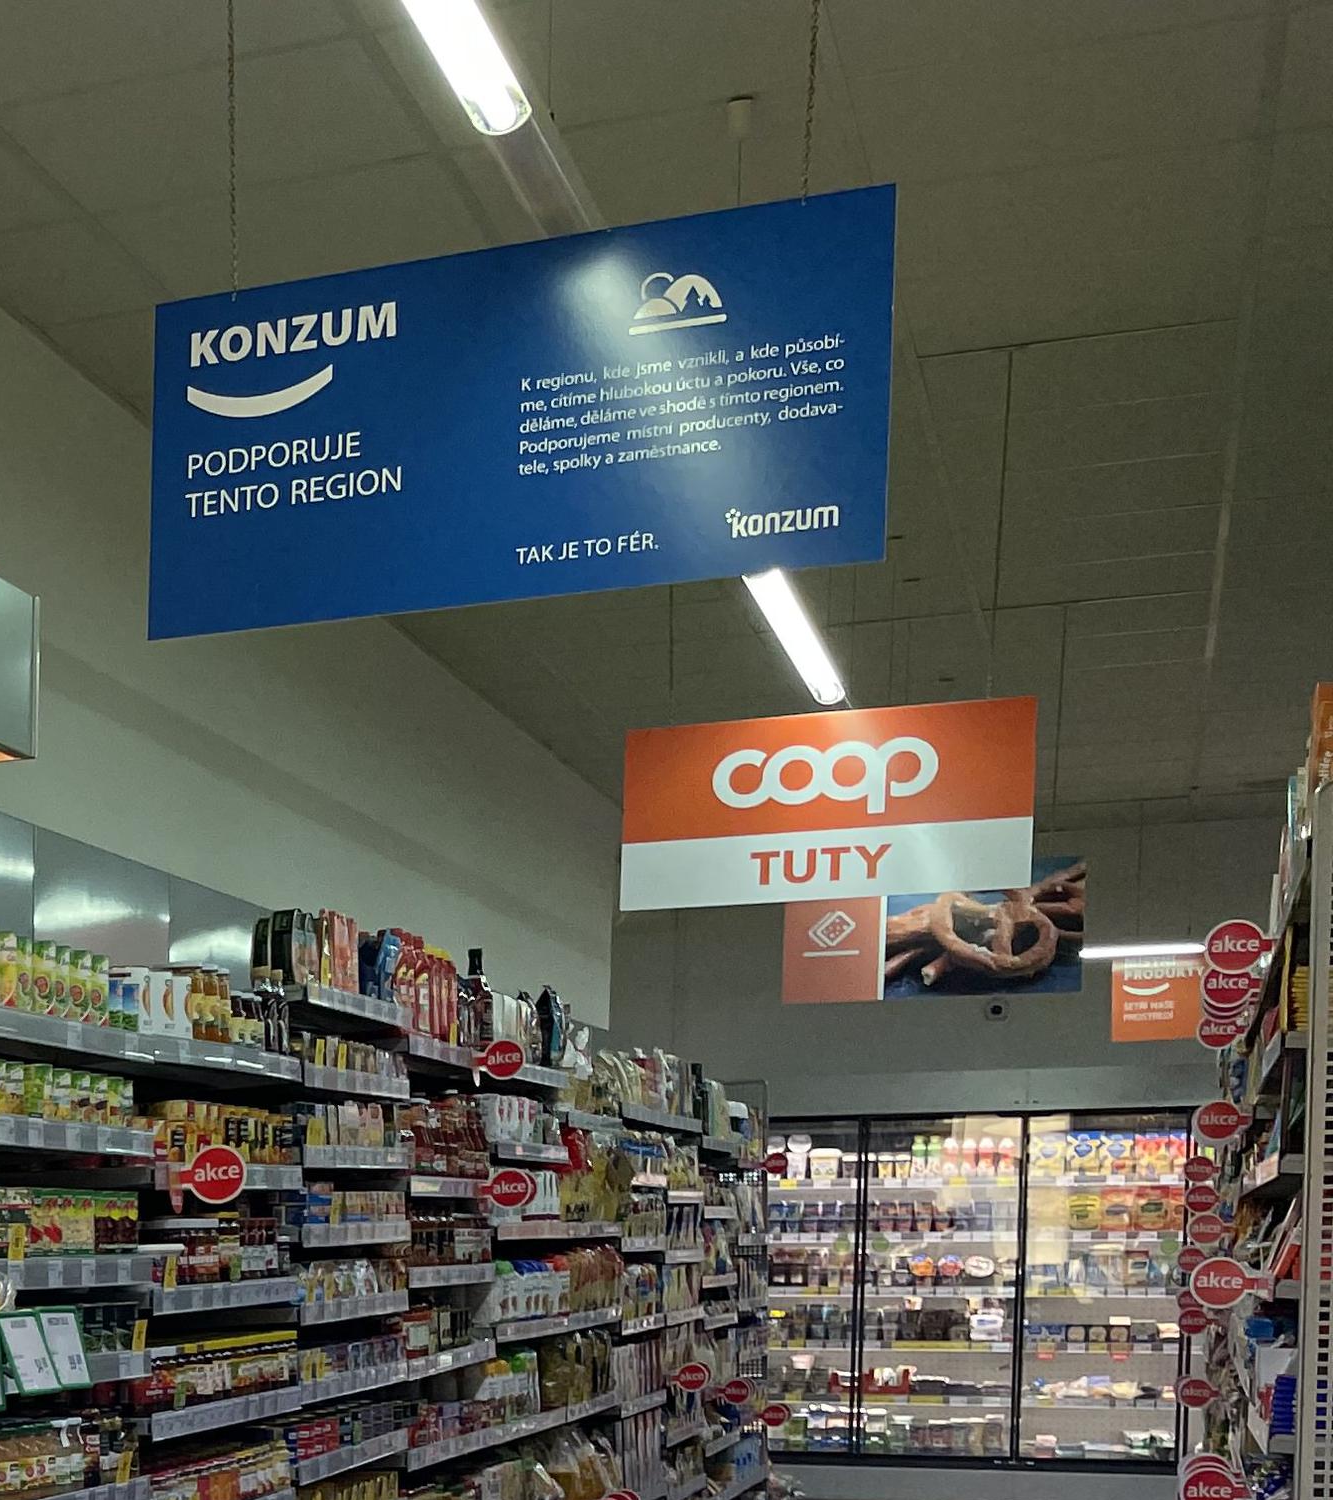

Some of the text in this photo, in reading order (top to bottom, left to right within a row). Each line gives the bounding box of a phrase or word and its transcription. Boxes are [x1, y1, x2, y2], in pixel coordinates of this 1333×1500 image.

[189, 301, 398, 368] KONZUM
[521, 336, 845, 391] K regionu, kde jsme vznikli, a kde působí-
[521, 358, 845, 414] me, cítíme hlubokou úctu a pokoru. Vše, co
[520, 381, 844, 434] děláme, děláme ve shodě s tímto regionem.
[520, 403, 843, 455] Podporujeme místní producenty, dodava-
[187, 431, 362, 479] PODPORUJE
[519, 438, 721, 476] tele, spolky a zaměstnance.
[185, 466, 403, 519] TENTO REGION
[732, 504, 840, 540] konzum
[516, 531, 659, 566] TAK JE TO FÉR.
[712, 736, 939, 814] coop
[751, 843, 892, 886] TUTY
[1211, 937, 1260, 952] akce
[487, 1052, 521, 1066] akce
[193, 1163, 240, 1182] akce
[493, 1181, 526, 1194] akce
[1196, 1272, 1243, 1289] akce
[1187, 1484, 1232, 1498] akce
